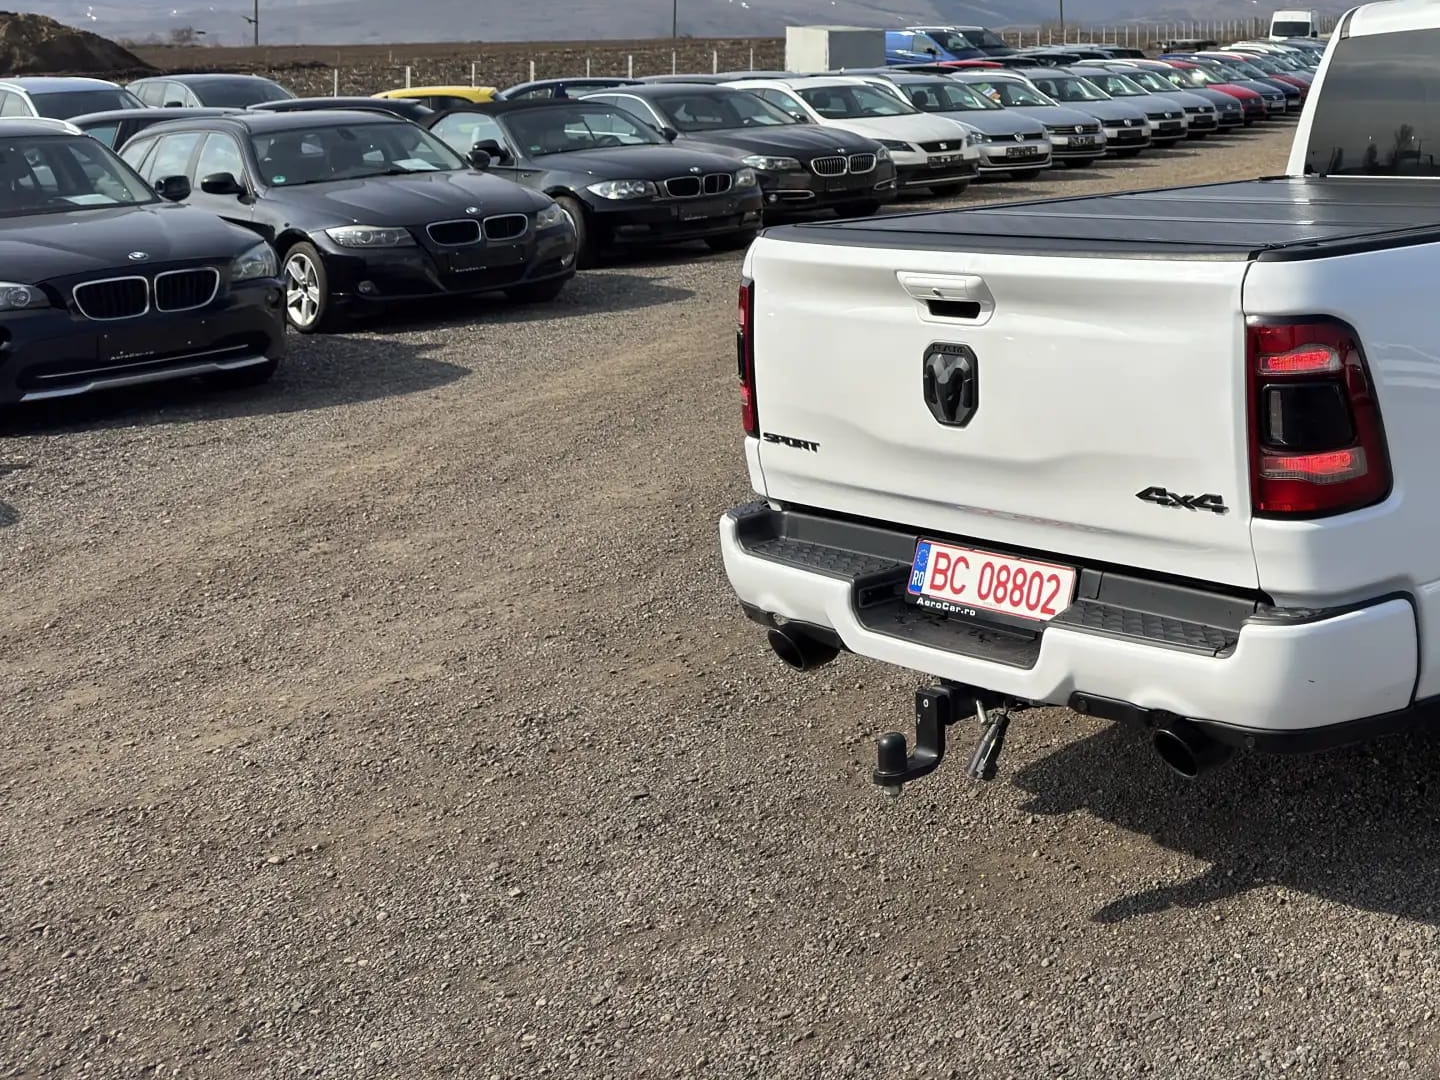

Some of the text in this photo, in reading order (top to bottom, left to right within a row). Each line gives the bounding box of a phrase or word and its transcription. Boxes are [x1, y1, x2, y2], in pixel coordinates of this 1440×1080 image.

[763, 432, 821, 453] SPORT
[1135, 486, 1229, 514] 4x4
[911, 569, 926, 588] RO
[929, 551, 1061, 616] BC 08802
[916, 596, 977, 617] AeroCar.ro
